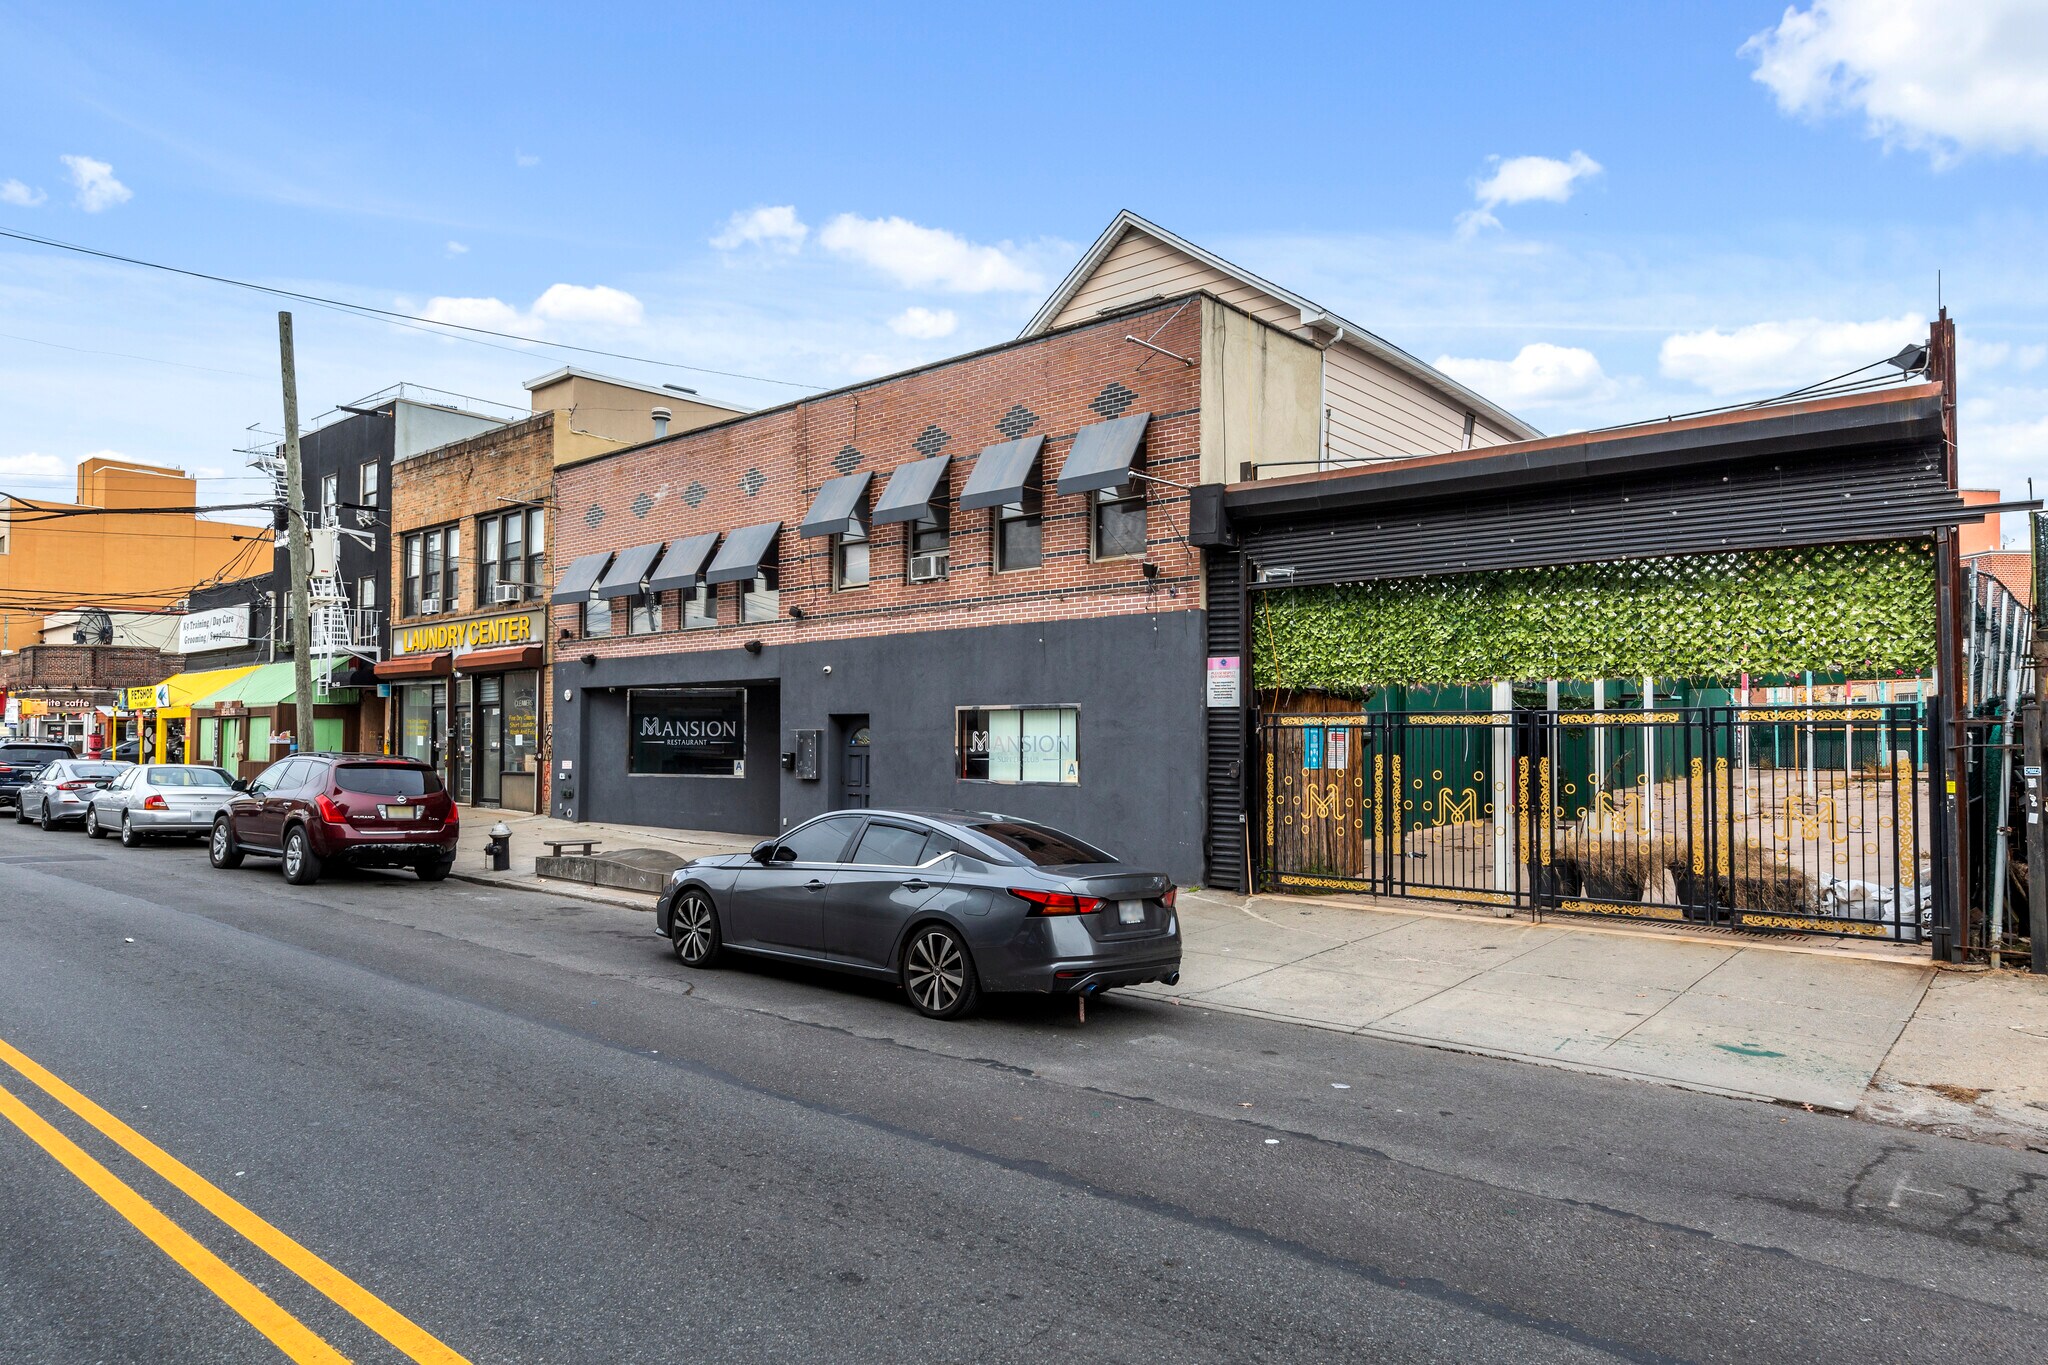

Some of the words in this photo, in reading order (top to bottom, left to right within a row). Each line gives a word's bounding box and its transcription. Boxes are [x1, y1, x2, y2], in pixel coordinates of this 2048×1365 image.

[190, 619, 209, 630] Training
[213, 616, 222, 626] Day
[223, 614, 234, 623] Care
[184, 634, 206, 644] Grooming
[210, 630, 230, 641] Supplies
[404, 624, 467, 652] LAUNDRY
[468, 616, 530, 646] CENTER
[131, 688, 152, 700] PETSHOP
[640, 717, 736, 736] MANSION
[970, 731, 1070, 752] MANSION
[736, 762, 742, 770] A
[1068, 764, 1075, 775] A
